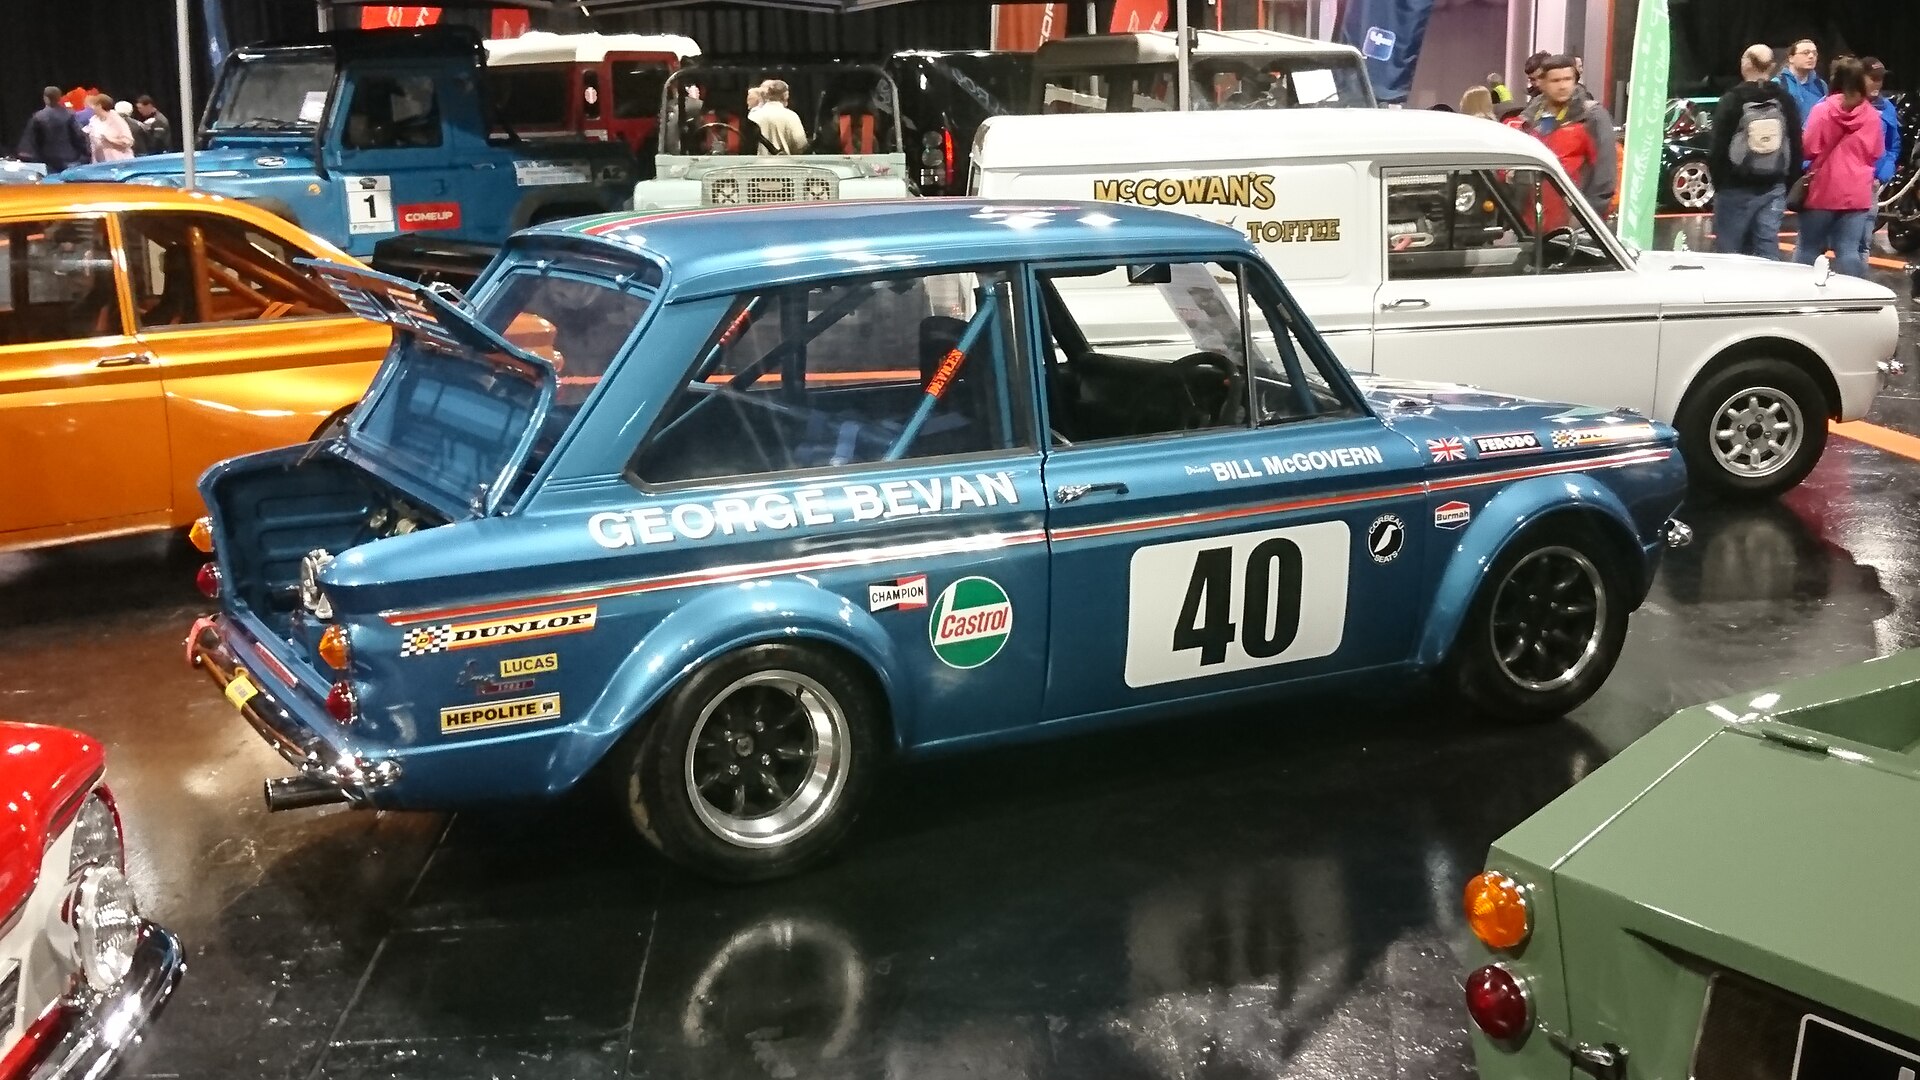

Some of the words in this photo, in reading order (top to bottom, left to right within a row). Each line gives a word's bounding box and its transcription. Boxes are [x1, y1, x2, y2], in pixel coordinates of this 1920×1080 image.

[363, 194, 376, 218] 1
[404, 211, 453, 222] COMEUP
[1247, 218, 1340, 243] TOFFEE
[1477, 434, 1536, 452] FERODO
[1210, 459, 1263, 482] BILL
[1262, 445, 1384, 475] McGOVERN
[587, 488, 836, 548] GEORGE
[842, 471, 1020, 521] BEVAN
[1436, 510, 1469, 521] Burmah
[1368, 514, 1405, 534] CORBEAU
[1373, 550, 1399, 564] SEATS
[871, 585, 924, 604] CHAMPION
[1172, 538, 1303, 667] 40
[452, 613, 592, 642] DUNLOP
[940, 606, 1009, 639] Castrol
[503, 656, 555, 674] LUCAS
[446, 703, 537, 726] HEPOLITE
